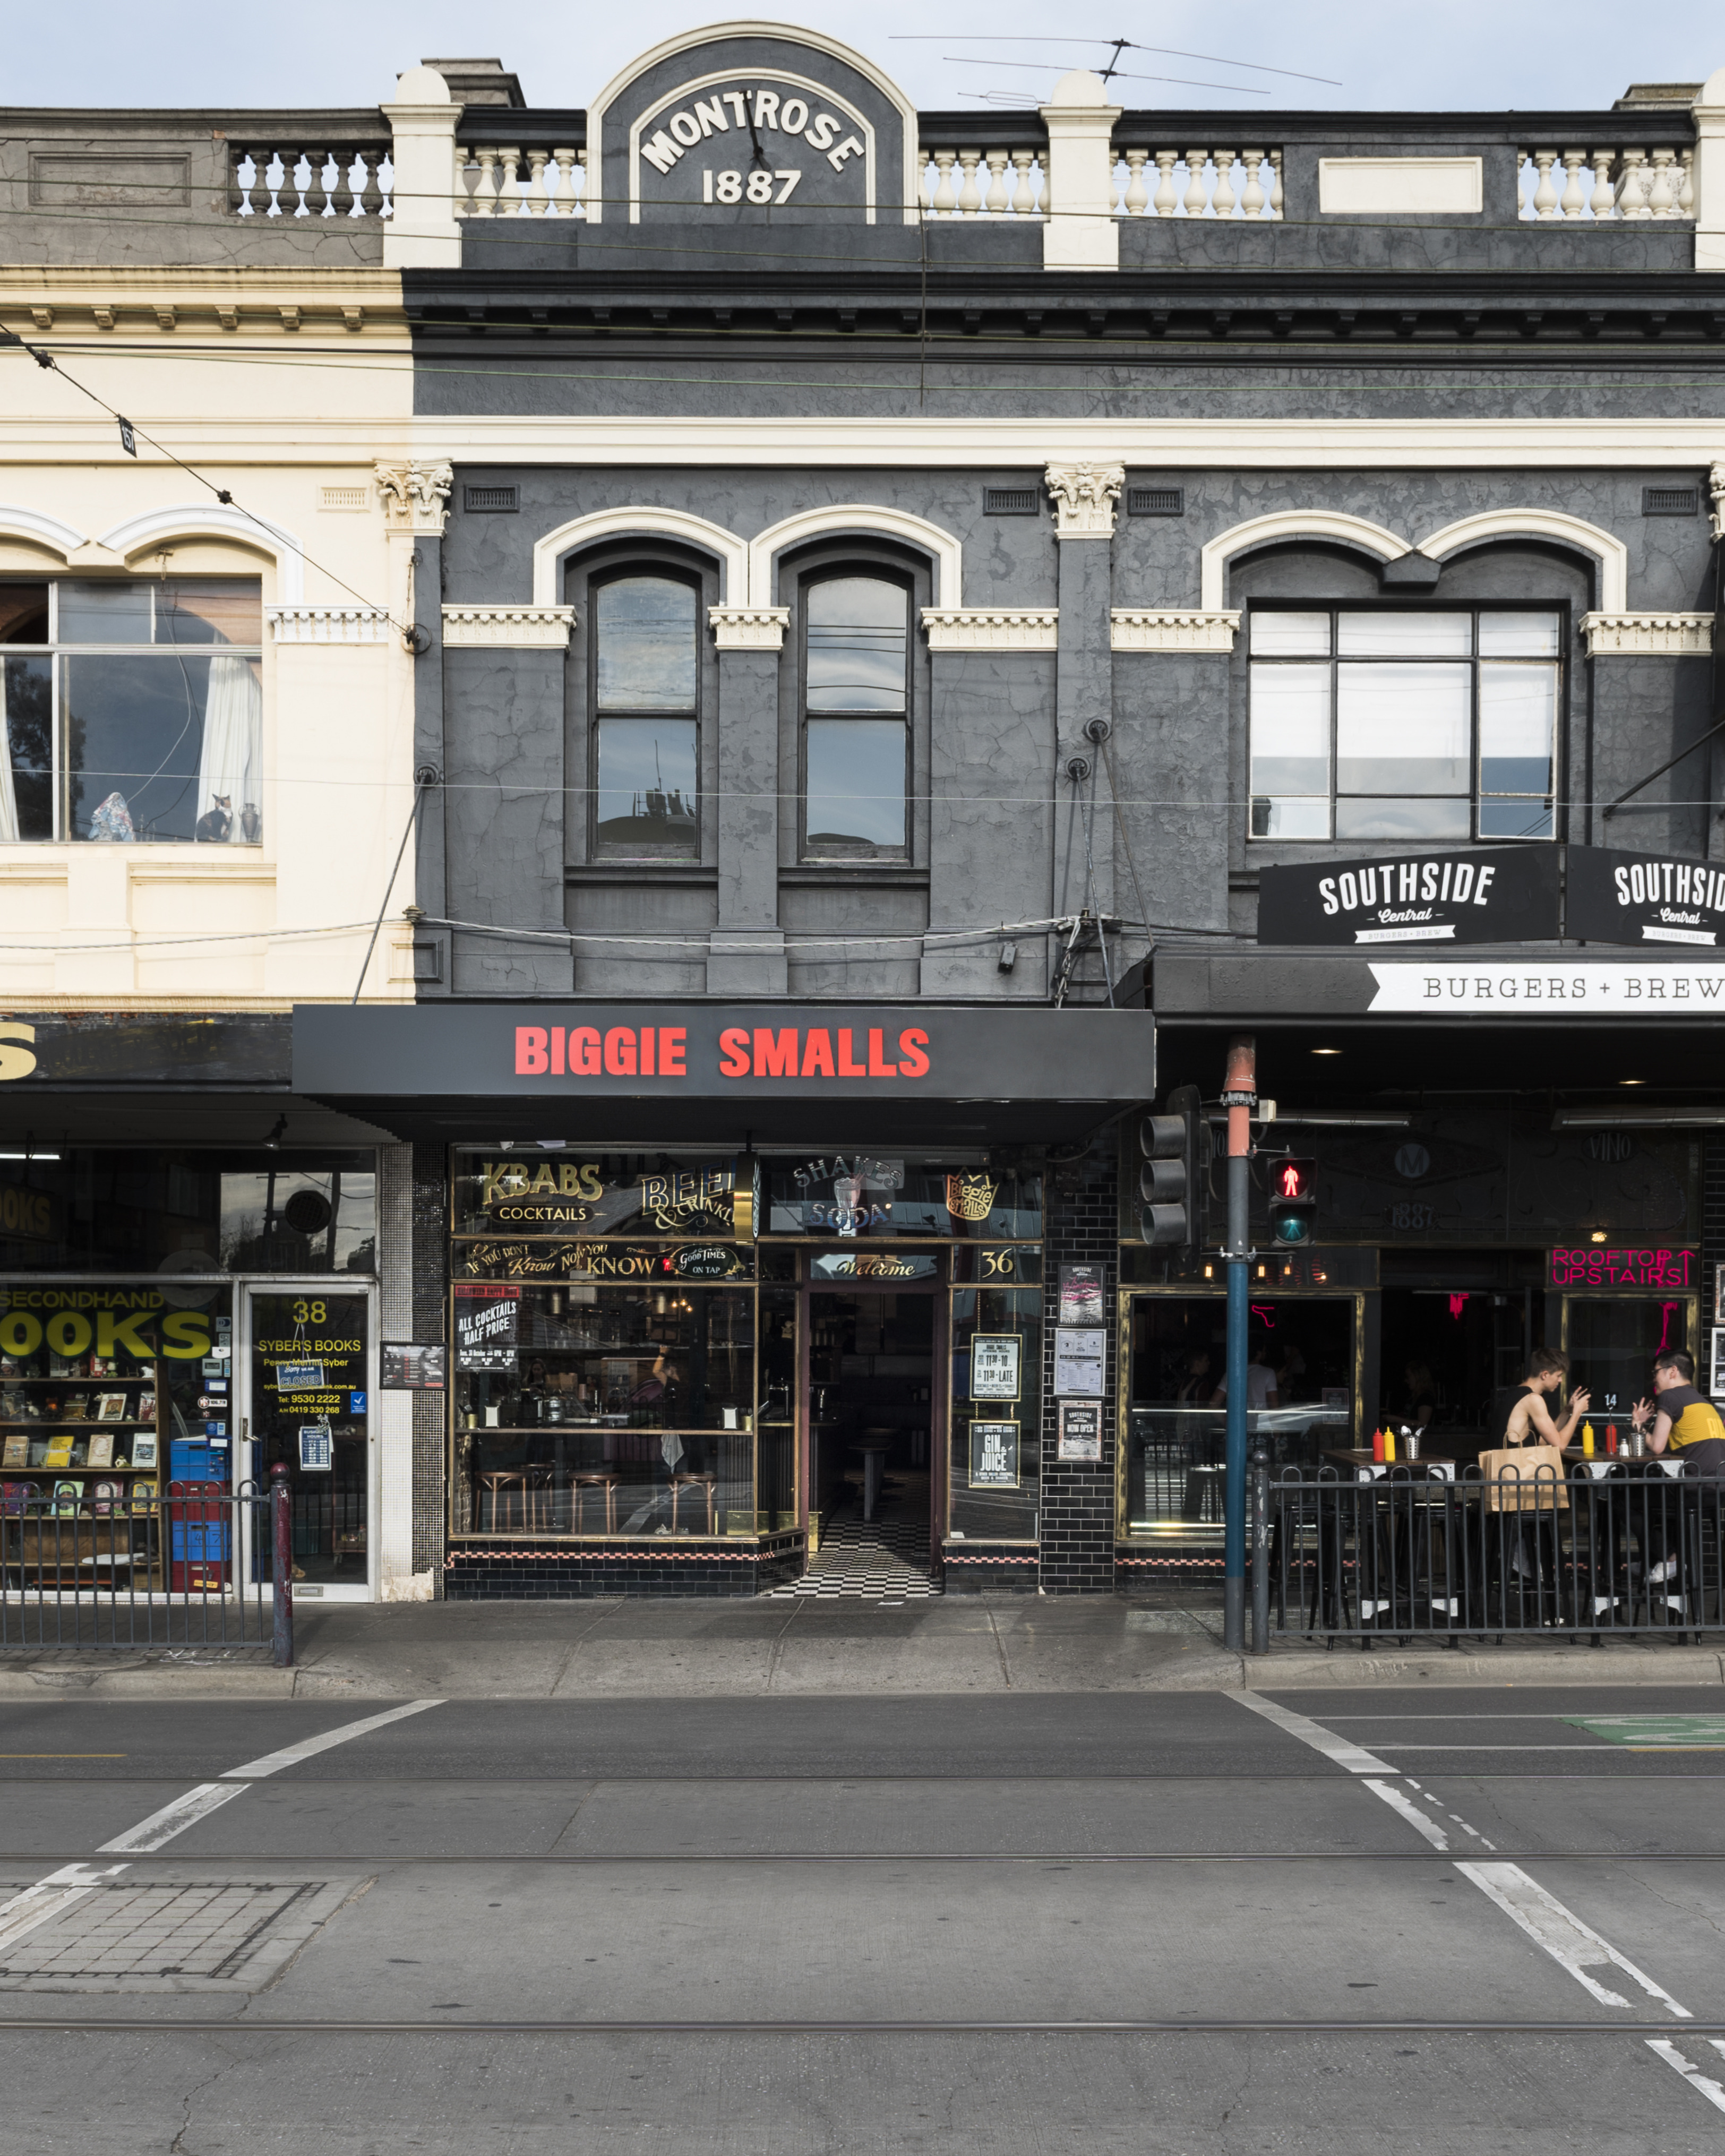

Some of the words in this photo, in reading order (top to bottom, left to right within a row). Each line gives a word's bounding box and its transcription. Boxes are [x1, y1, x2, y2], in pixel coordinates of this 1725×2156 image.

[641, 90, 865, 174] MONTROSE
[703, 170, 801, 204] 1887
[122, 425, 134, 450] 157
[1319, 862, 1495, 915] SOUTHSIDE
[1378, 907, 1432, 923] Central
[1660, 907, 1700, 924] Central
[1368, 931, 1408, 940] BURGERS
[1423, 978, 1586, 998] BURGERS
[1624, 978, 1725, 998] BREW
[515, 1026, 686, 1076] BIGGIE
[719, 1028, 930, 1077] SMALLS
[793, 1155, 903, 1190] SHAKES
[482, 1163, 603, 1206] KBABS
[499, 1207, 586, 1221] COCKTAILS
[677, 1197, 735, 1223] CRINKL
[809, 1204, 890, 1230] SODA
[1392, 1201, 1435, 1230] 1887
[467, 1261, 480, 1274] IF
[481, 1249, 501, 1266] YOU
[508, 1257, 555, 1275] Know
[561, 1248, 586, 1272] NOW
[586, 1244, 608, 1256] YOU
[587, 1257, 656, 1275] KNOW
[836, 1257, 916, 1277] Welcome
[981, 1248, 1014, 1278] 36
[1552, 1249, 1672, 1267] ROOFTOP
[1552, 1268, 1682, 1286] UPSTAIRS
[0, 1291, 165, 1308] SECONDHAND
[293, 1301, 327, 1324] 38
[459, 1317, 473, 1332] ALL
[475, 1301, 517, 1327] COCKTAILS
[465, 1327, 484, 1345] HALF
[486, 1317, 510, 1337] PRICE
[259, 1339, 312, 1352] SYBER'S
[314, 1339, 362, 1352] BOOKS
[263, 1359, 290, 1368] Penny
[280, 1375, 321, 1386] CLOSED
[999, 1370, 1013, 1382] LATE
[291, 1395, 315, 1403] 9530
[316, 1395, 340, 1403] 2222
[1604, 1394, 1617, 1406] 14
[1067, 1424, 1079, 1432] NOW
[1080, 1424, 1094, 1432] OPEN
[984, 1434, 1001, 1453] GIN
[980, 1452, 1007, 1471] JUICE
